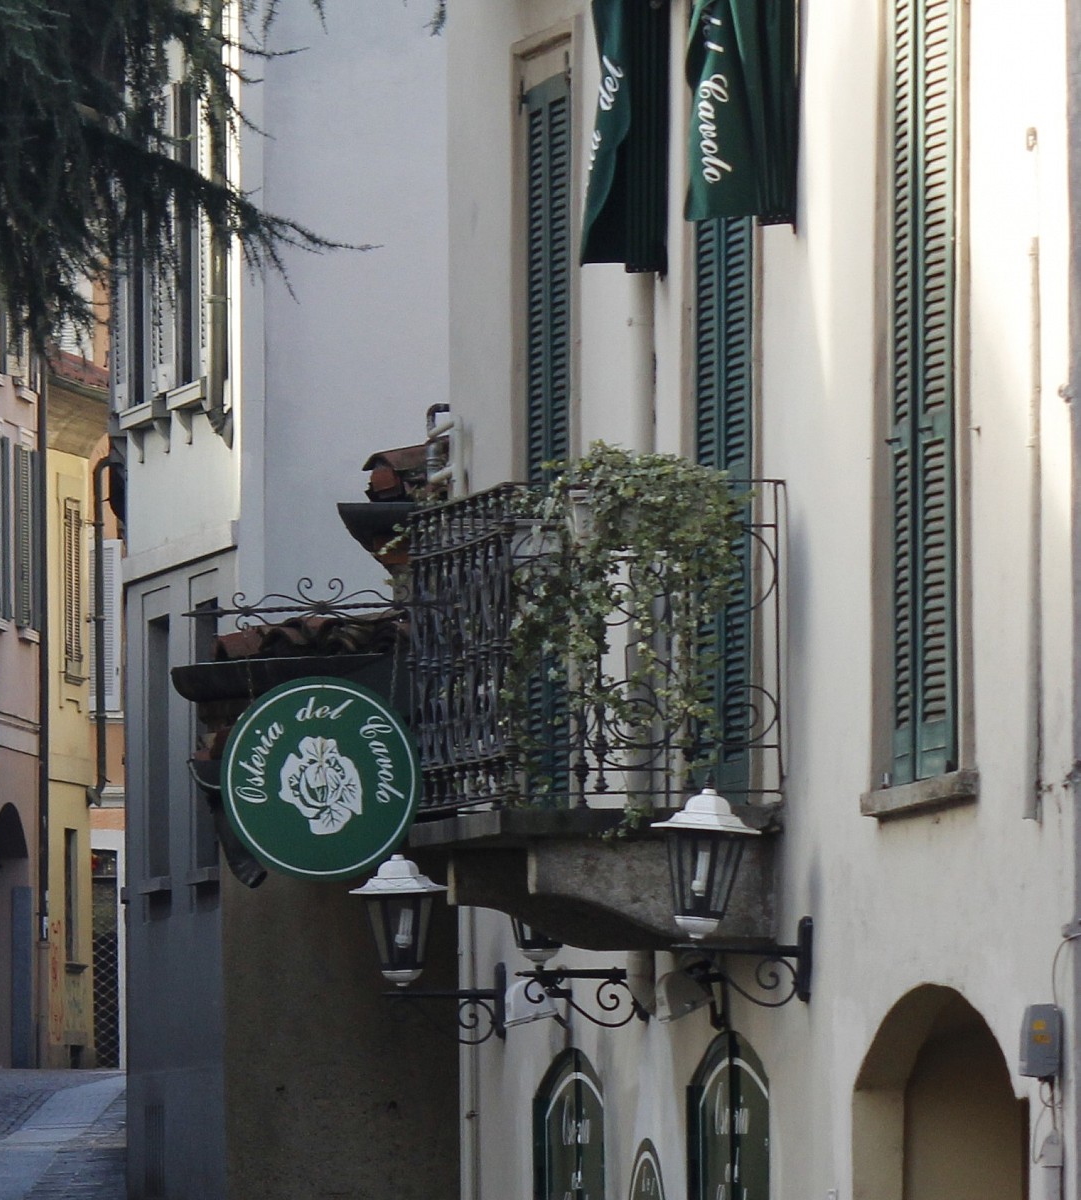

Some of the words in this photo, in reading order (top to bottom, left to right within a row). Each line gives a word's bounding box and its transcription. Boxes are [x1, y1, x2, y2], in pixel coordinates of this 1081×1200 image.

[698, 74, 732, 184] Cavolo
[234, 721, 285, 804] Osteria
[295, 696, 354, 722] del
[359, 715, 405, 804] Cavolo
